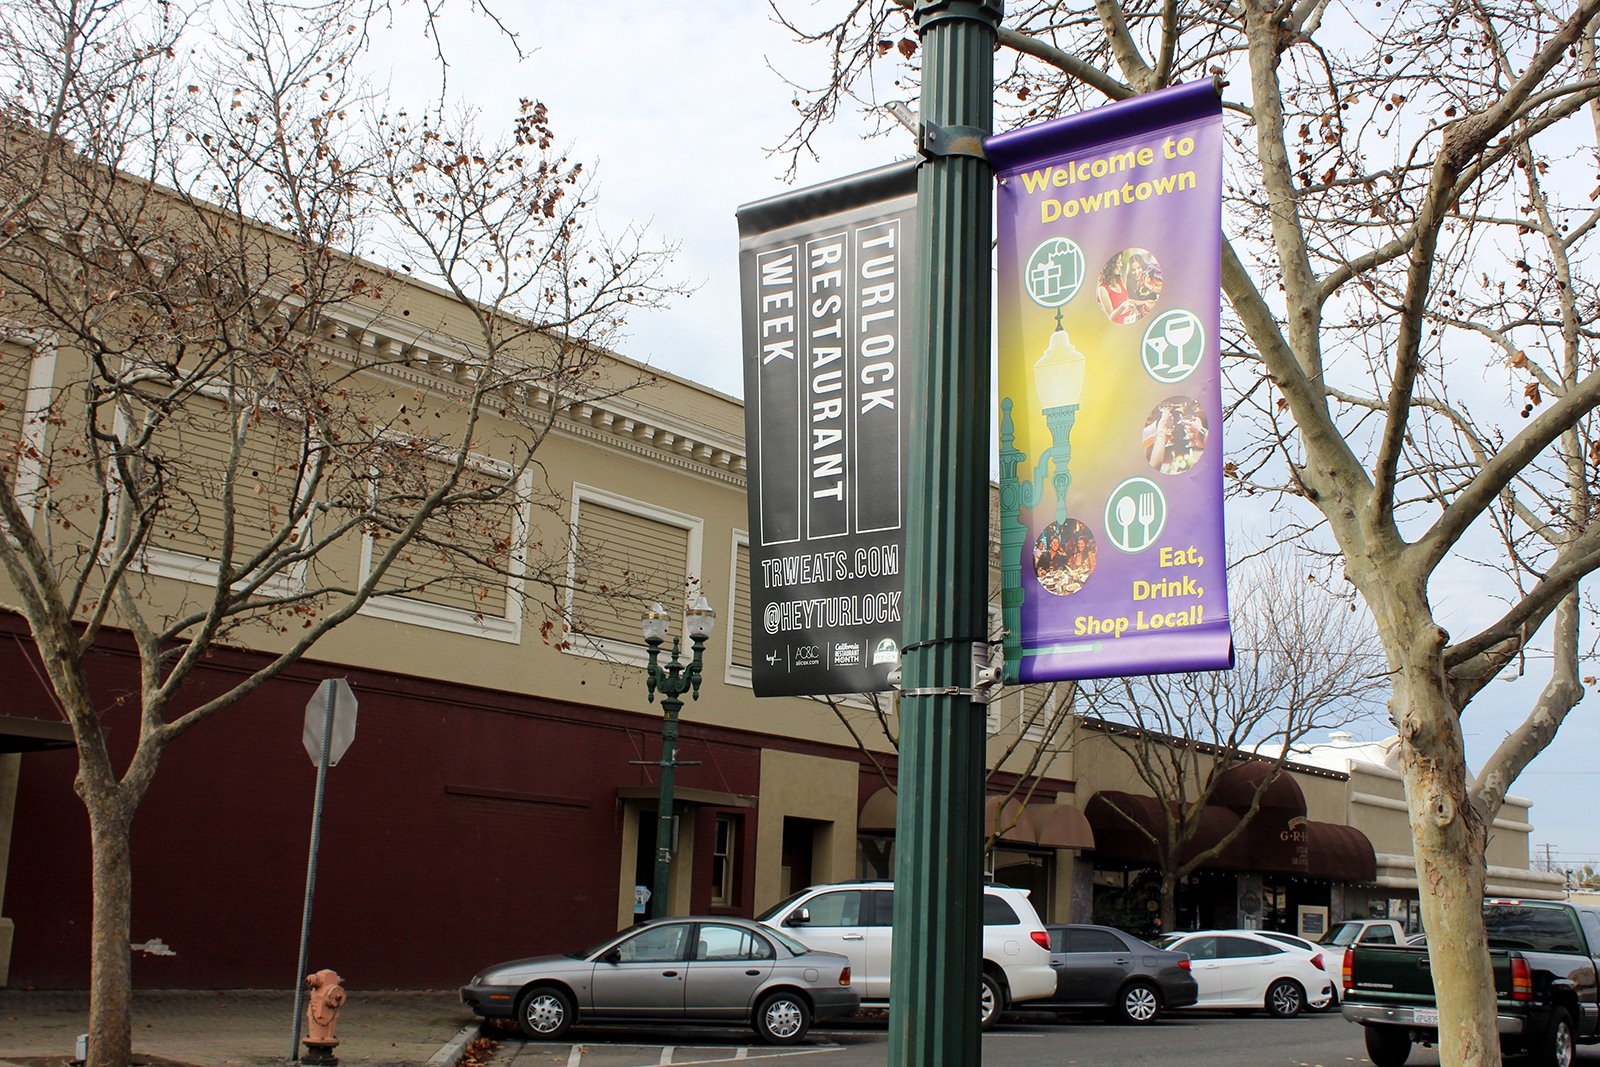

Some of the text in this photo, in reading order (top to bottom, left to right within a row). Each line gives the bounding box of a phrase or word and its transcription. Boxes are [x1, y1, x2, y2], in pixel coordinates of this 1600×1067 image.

[1021, 137, 1195, 194] Welcome to
[1041, 171, 1196, 223] Downtown
[762, 254, 794, 366] WEEK
[860, 229, 895, 415] TURLOCK
[811, 243, 842, 501] RESTAURANT
[761, 544, 899, 588] TRWEATS.COM
[1159, 545, 1204, 568] Eat,
[1133, 576, 1204, 600] Drink,
[763, 591, 902, 635] @HEYTURLOCK
[1074, 605, 1203, 638] Shop Local!
[834, 642, 860, 650] California
[834, 649, 860, 657] RESTAURANT
[834, 656, 860, 664] MONTH
